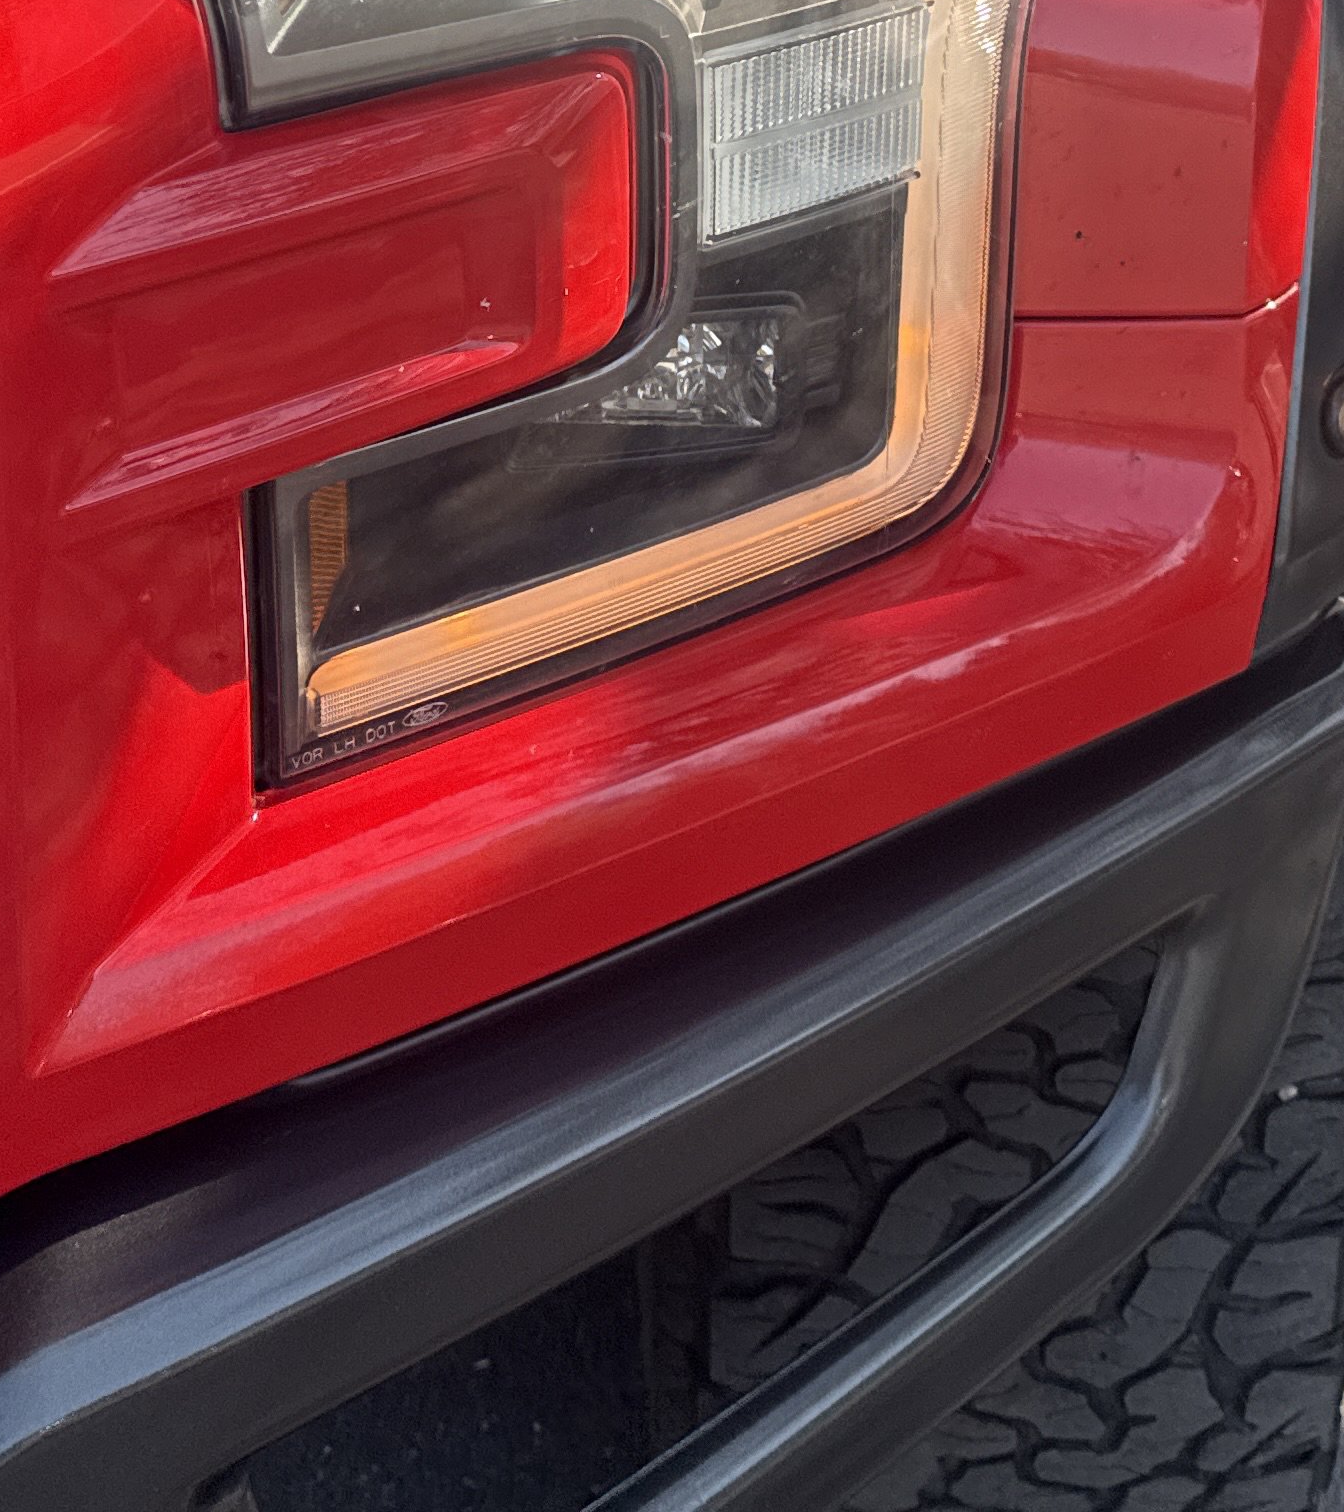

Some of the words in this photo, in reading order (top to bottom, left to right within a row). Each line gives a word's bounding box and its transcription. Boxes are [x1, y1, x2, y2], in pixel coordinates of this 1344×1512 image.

[291, 747, 324, 769] VOR
[334, 736, 356, 754] LH
[365, 721, 396, 743] DOT
[406, 703, 444, 725] Ford
